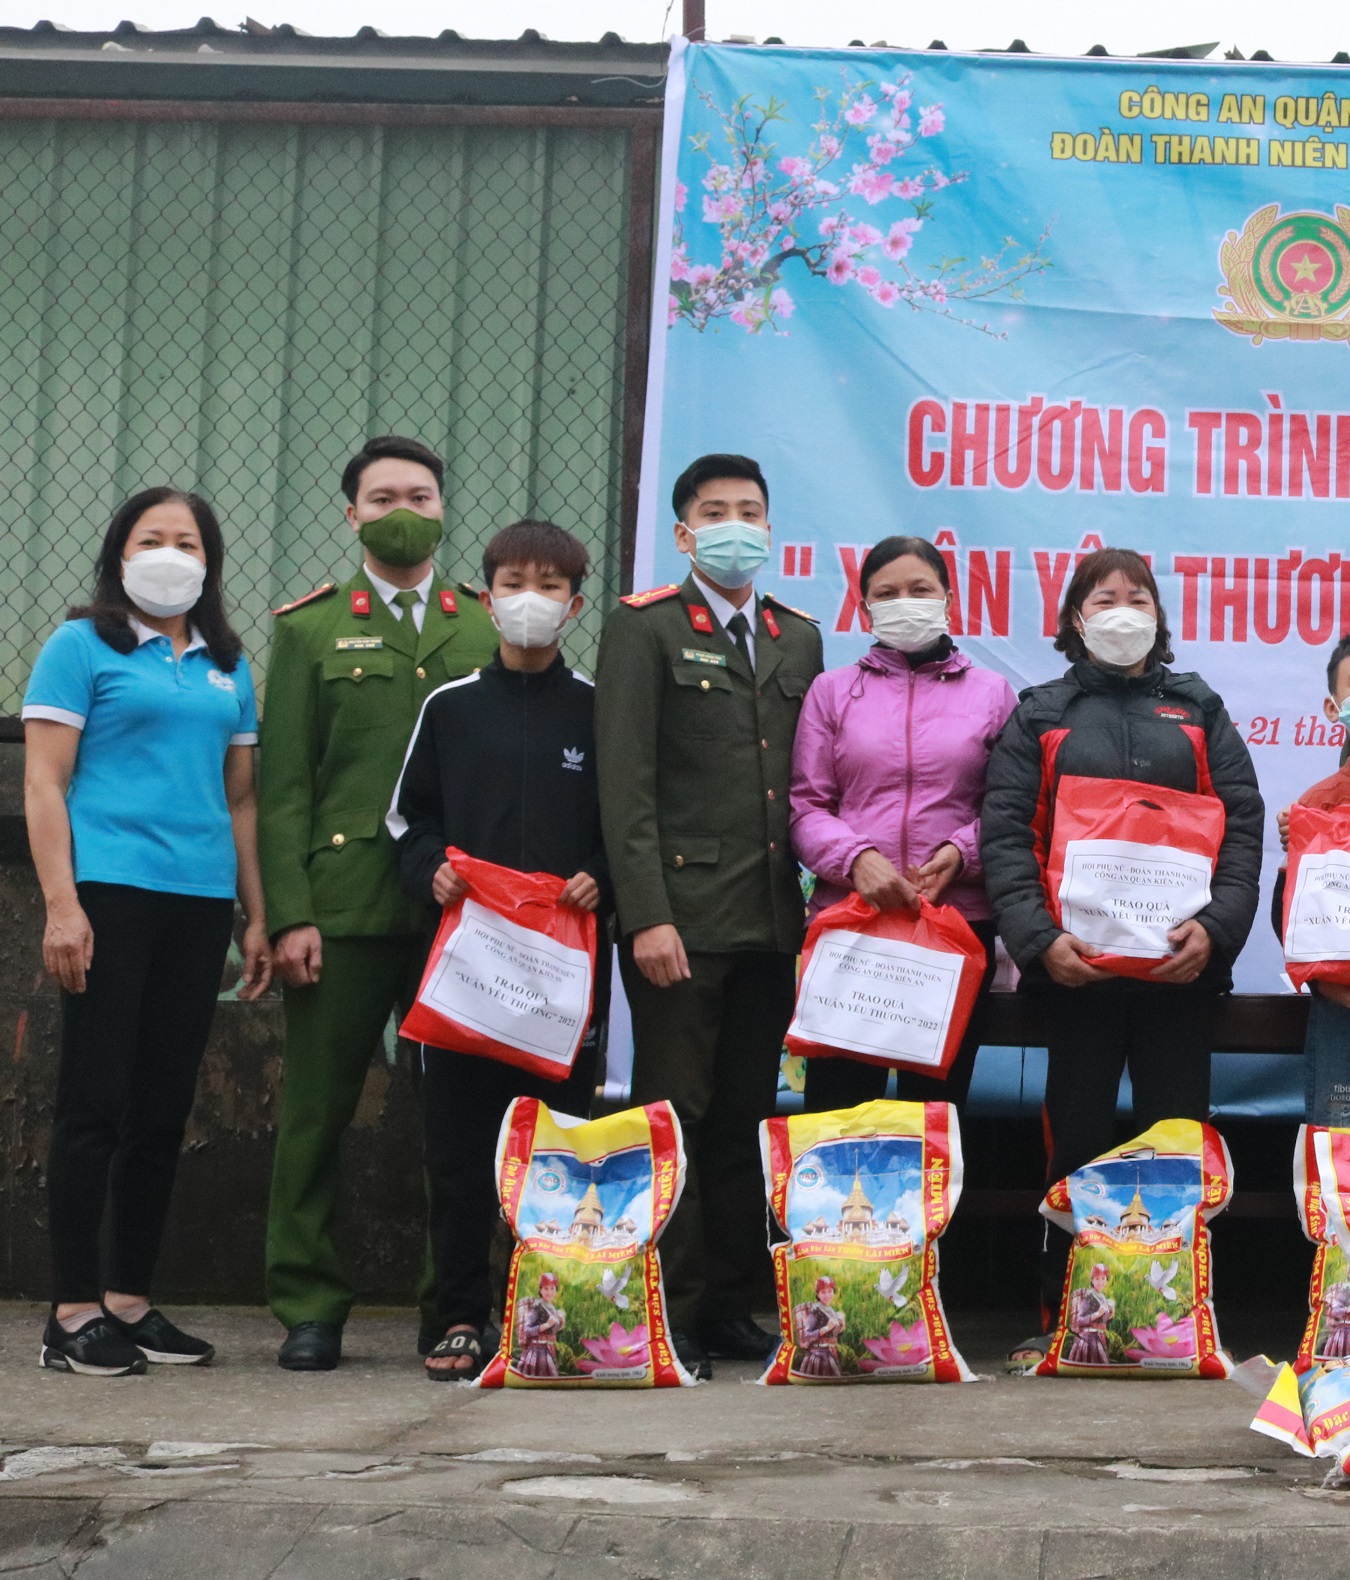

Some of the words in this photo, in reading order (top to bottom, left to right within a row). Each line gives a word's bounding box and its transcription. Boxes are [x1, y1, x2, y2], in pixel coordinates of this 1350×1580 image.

[1120, 85, 1210, 122] CÔNG
[1218, 94, 1267, 125] AN
[1051, 127, 1143, 164] ĐOÀN
[1151, 135, 1260, 166] THANH
[1269, 136, 1348, 170] NIÊN
[907, 396, 1167, 493] CHƯƠNG
[834, 530, 1011, 637] XÂN
[1247, 716, 1281, 746] 21
[1155, 869, 1181, 878] THANH
[1112, 898, 1143, 909] TRAO
[1147, 901, 1170, 912] QUÀ
[1112, 910, 1131, 920] YÊU
[494, 975, 525, 995] TRAO
[488, 987, 509, 1002] YÊU
[558, 1015, 576, 1028] 2022
[852, 991, 881, 1004] TRAO
[883, 998, 904, 1010] QUÀ
[847, 1004, 866, 1015] YÊU
[918, 1019, 938, 1031] 2022
